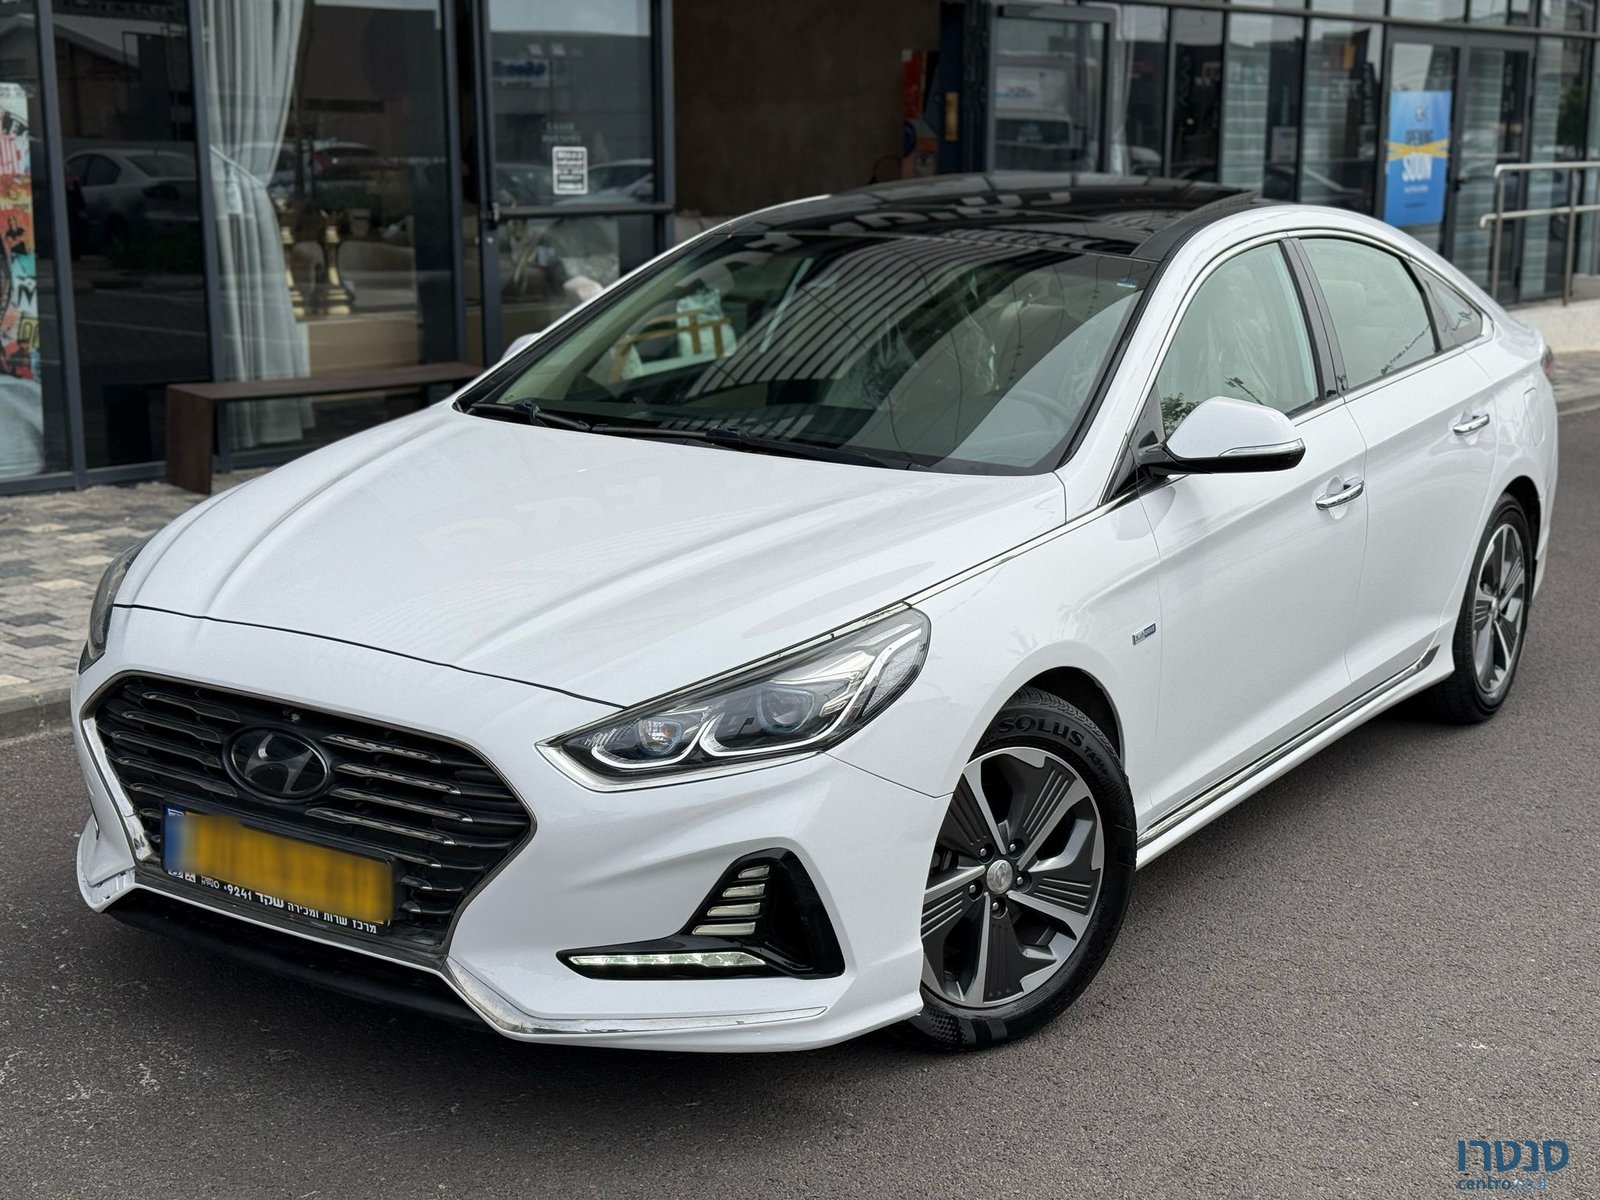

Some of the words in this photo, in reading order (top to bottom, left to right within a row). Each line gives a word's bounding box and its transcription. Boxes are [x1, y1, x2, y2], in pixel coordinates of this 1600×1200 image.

[998, 715, 1084, 746] SOLUS
[255, 892, 284, 908] שקד
[287, 902, 319, 918] ומכירה
[323, 912, 348, 926] שרות
[352, 919, 377, 934] מרכז
